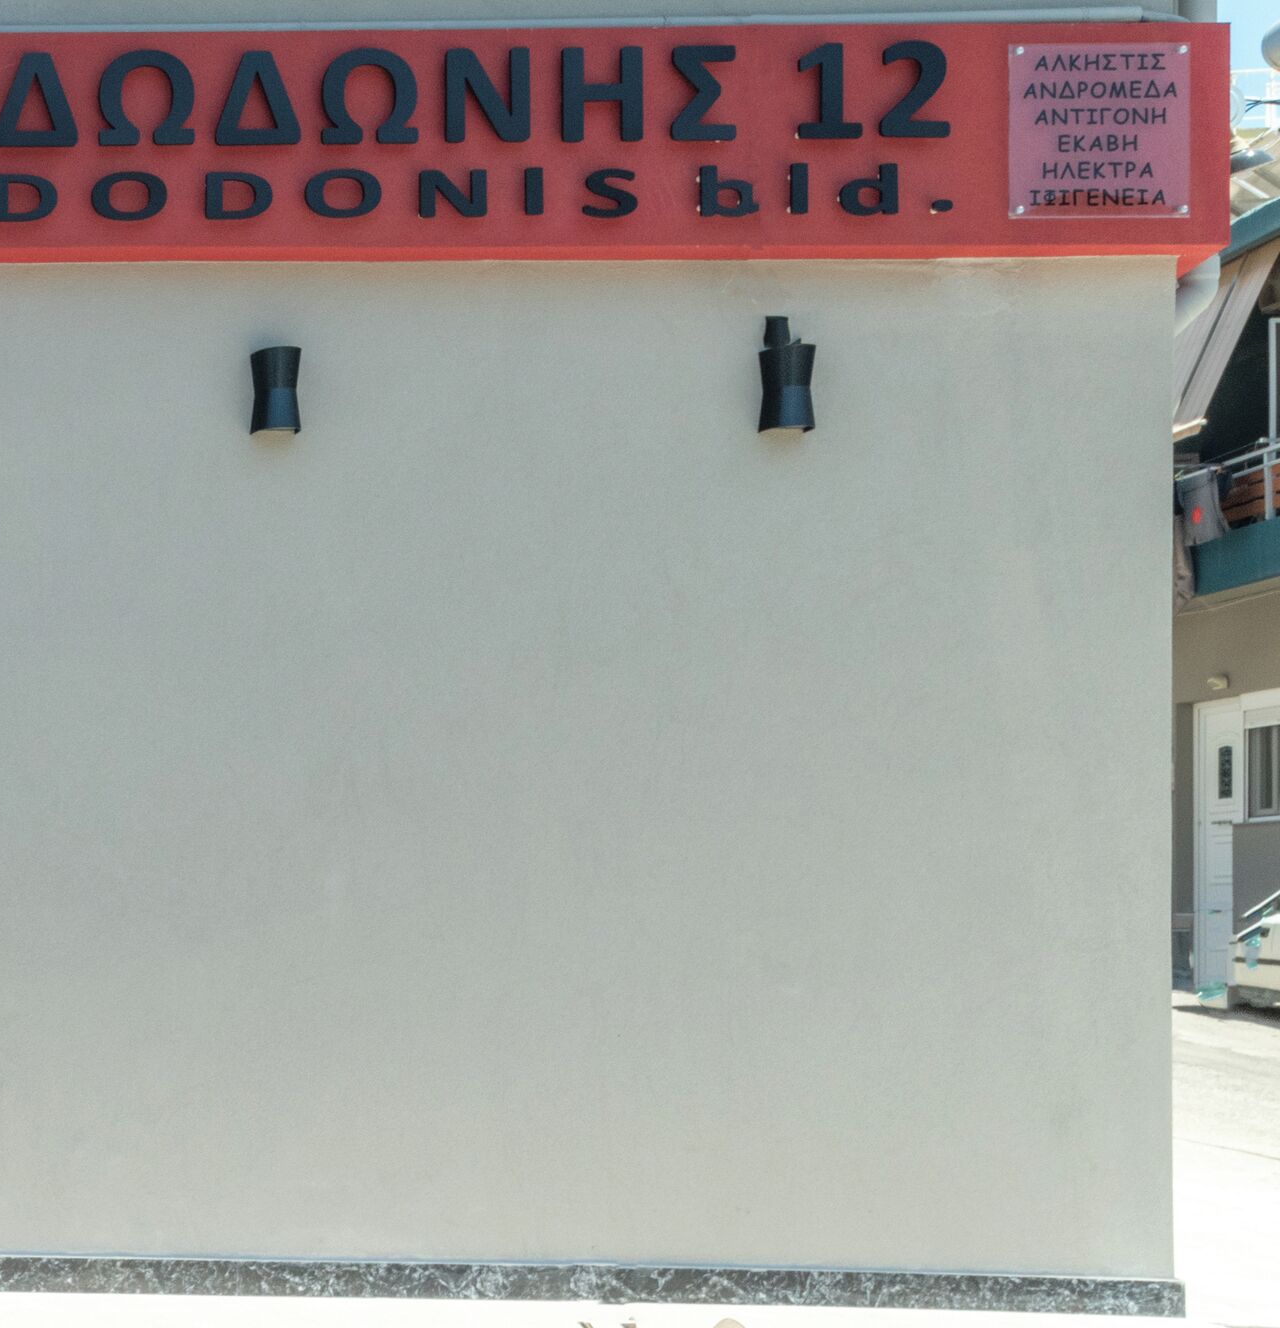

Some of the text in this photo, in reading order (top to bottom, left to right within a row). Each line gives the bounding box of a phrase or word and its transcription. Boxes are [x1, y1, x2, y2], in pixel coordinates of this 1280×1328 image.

[1034, 52, 1167, 72] ΑΛΚΗΣΤΙΣ
[796, 40, 952, 140] 12
[1023, 79, 1178, 100] ΑΝΔΡΟΜΕΔΑ
[1034, 106, 1167, 126] ΑΝΤΙΓΟΝΗ
[1057, 134, 1139, 153] ΕΚΑΒΗ
[1041, 161, 1154, 180] ΗΛΕΚΤΡΑ
[697, 162, 954, 218] bld.
[1029, 188, 1167, 208] ΙΦΙΓΕΝΕΙΑ
